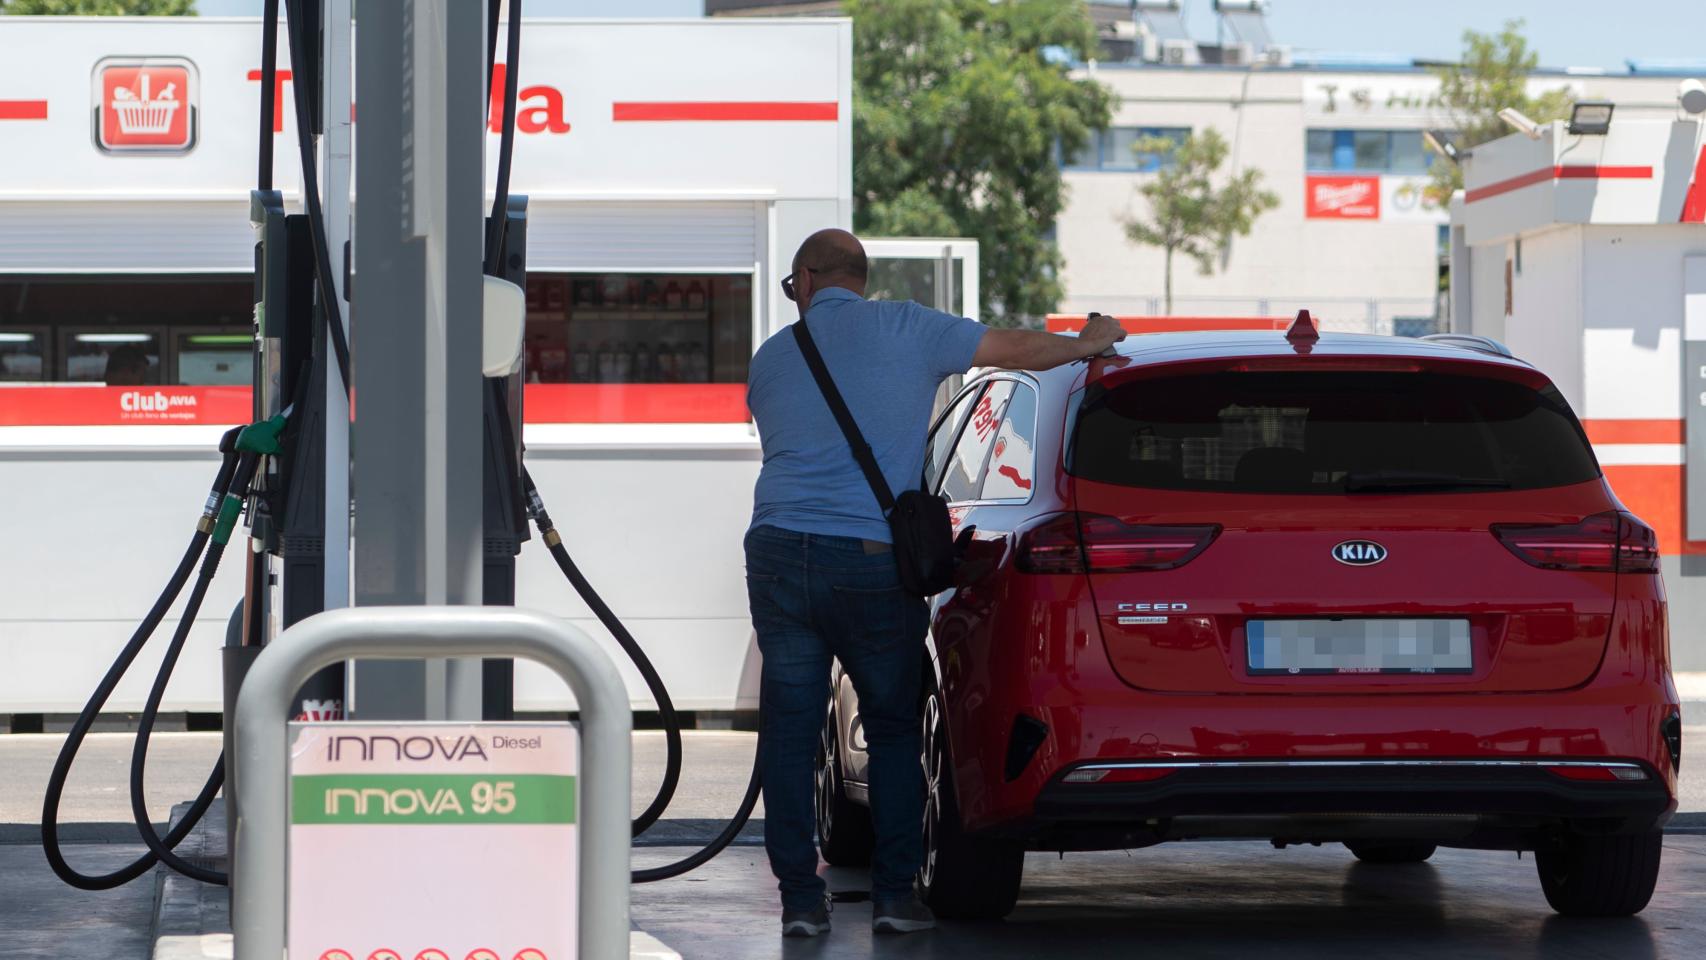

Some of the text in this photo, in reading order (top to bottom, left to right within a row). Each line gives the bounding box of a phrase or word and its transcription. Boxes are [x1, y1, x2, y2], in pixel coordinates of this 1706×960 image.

[121, 391, 196, 411] Club AVIA
[1341, 544, 1379, 560] KIA
[1118, 603, 1188, 612] CEED
[492, 735, 542, 749] Diesel
[471, 780, 517, 814] 95
